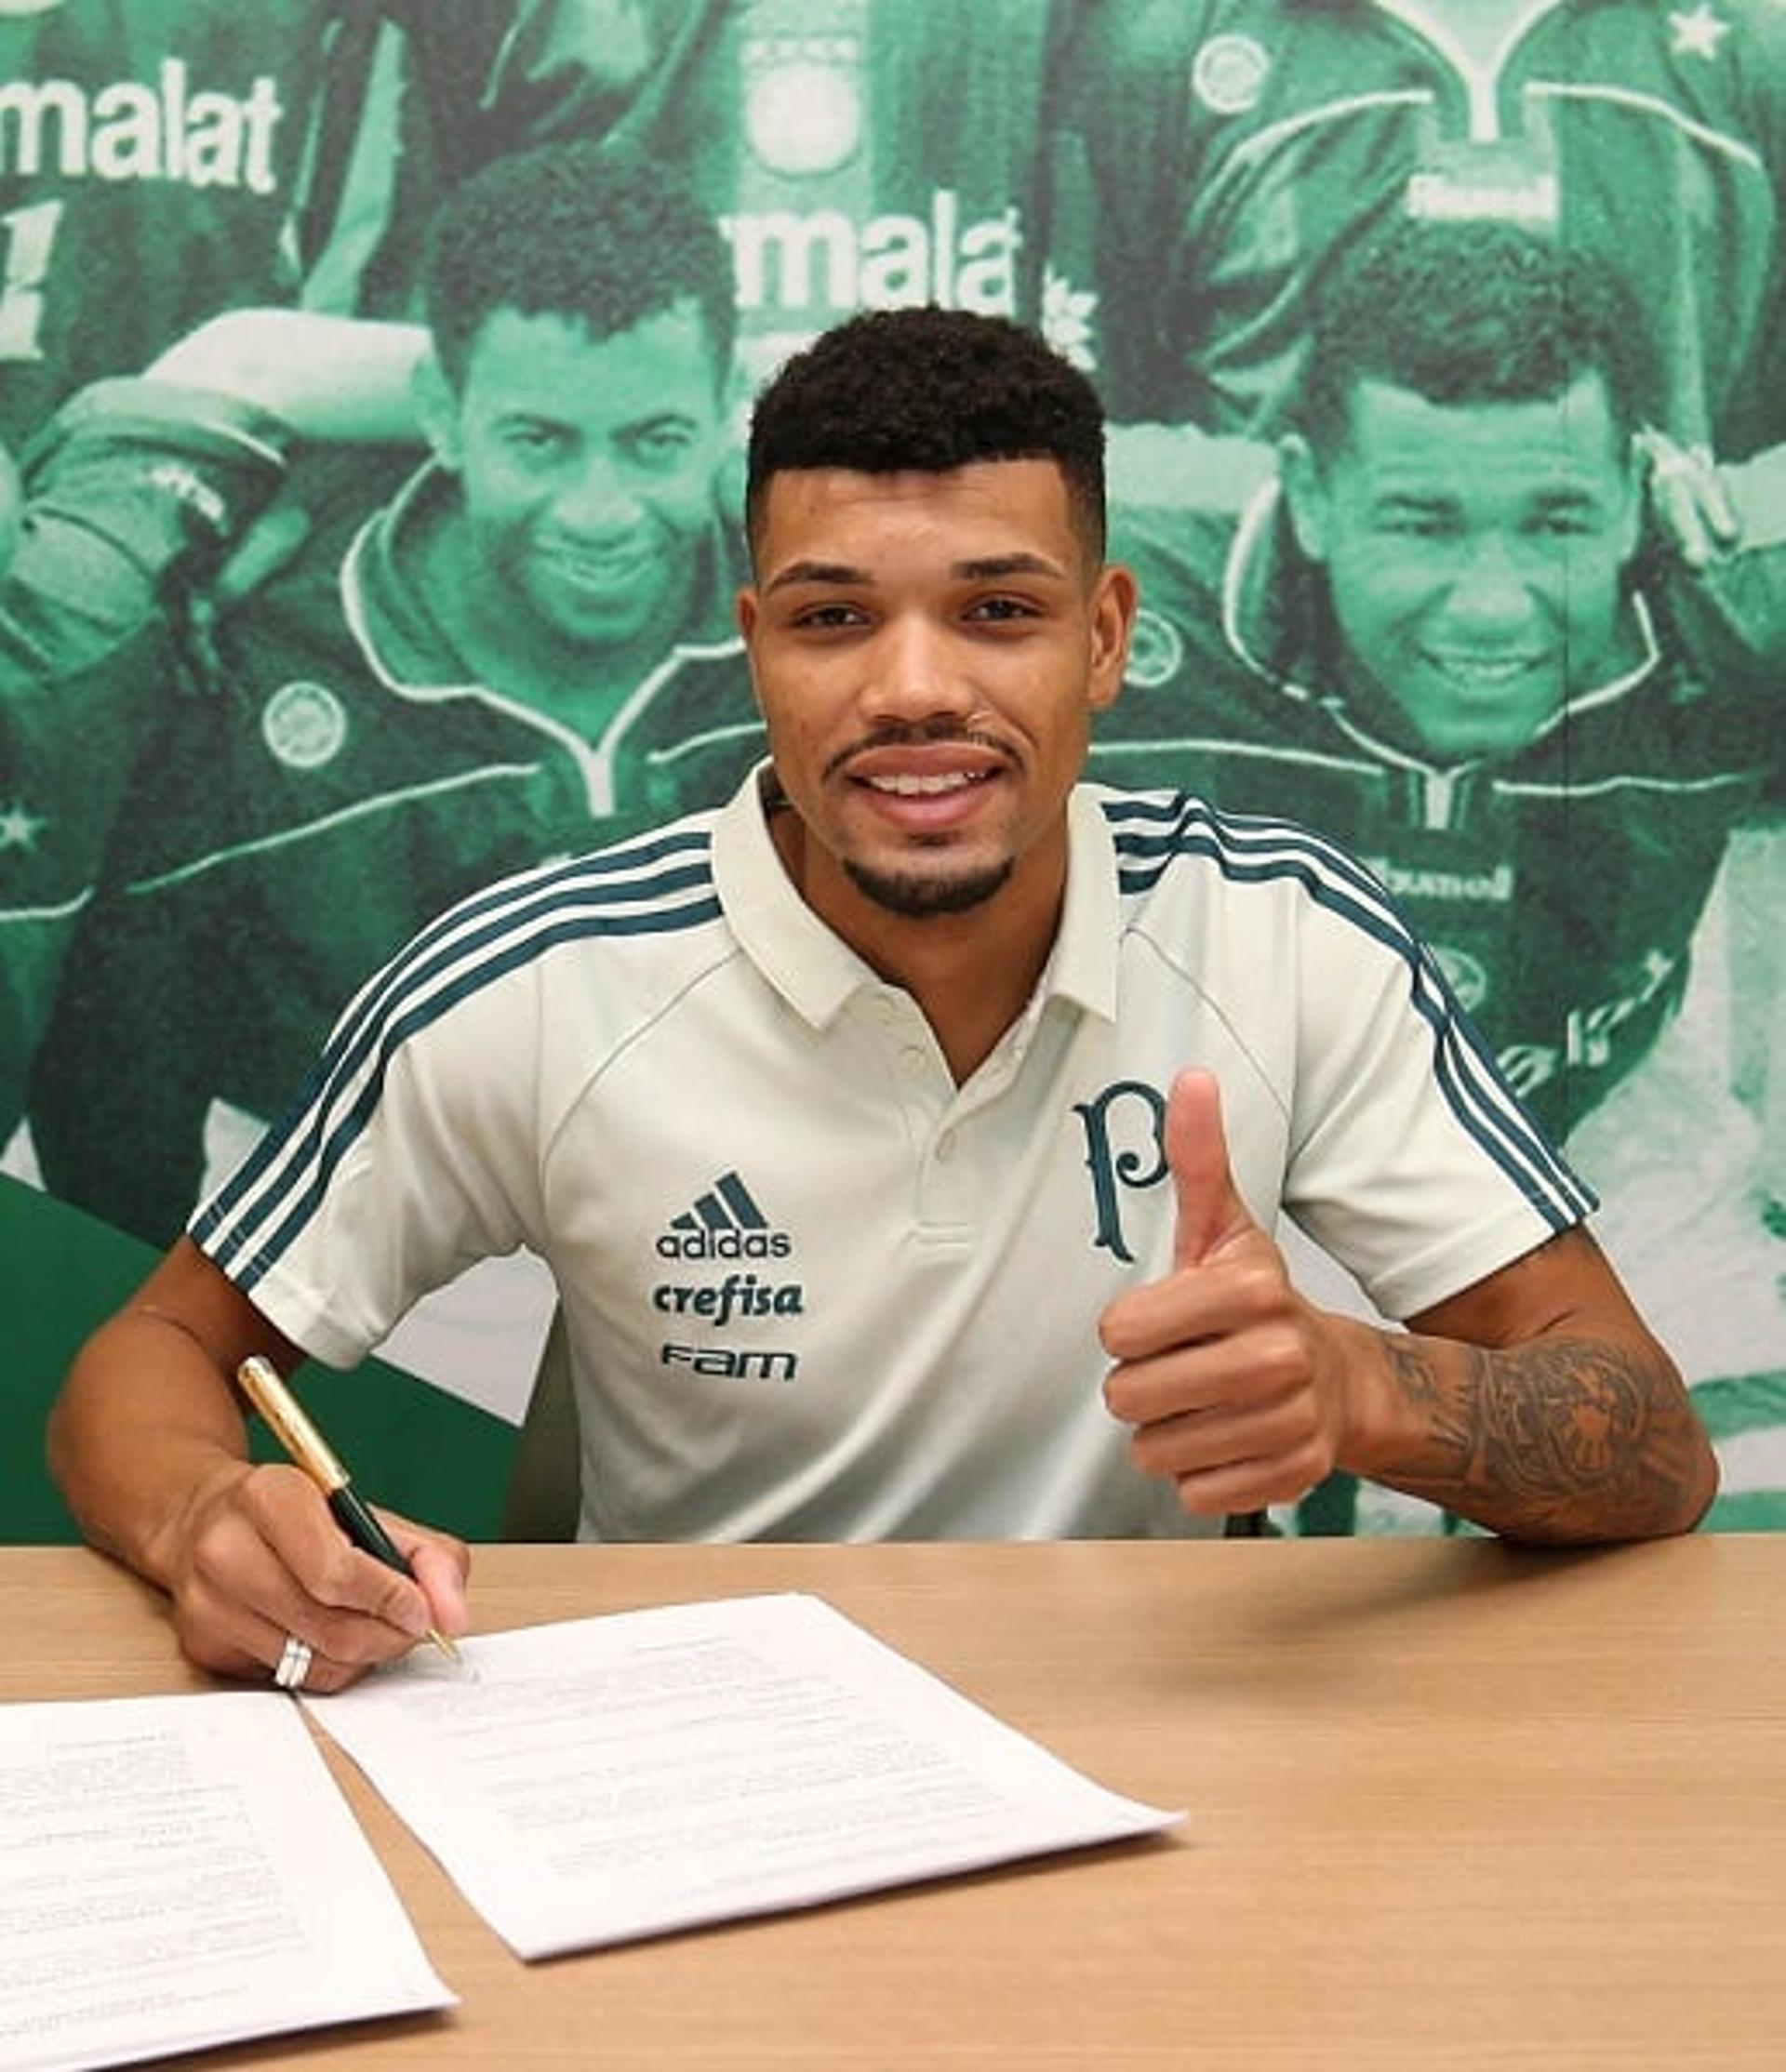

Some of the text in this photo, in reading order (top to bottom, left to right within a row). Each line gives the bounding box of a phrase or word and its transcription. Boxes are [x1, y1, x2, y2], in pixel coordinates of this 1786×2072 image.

[0, 57, 284, 194] malat
[717, 189, 1022, 317] mala
[656, 1229, 791, 1259] adidas
[653, 1273, 804, 1327] crefisa
